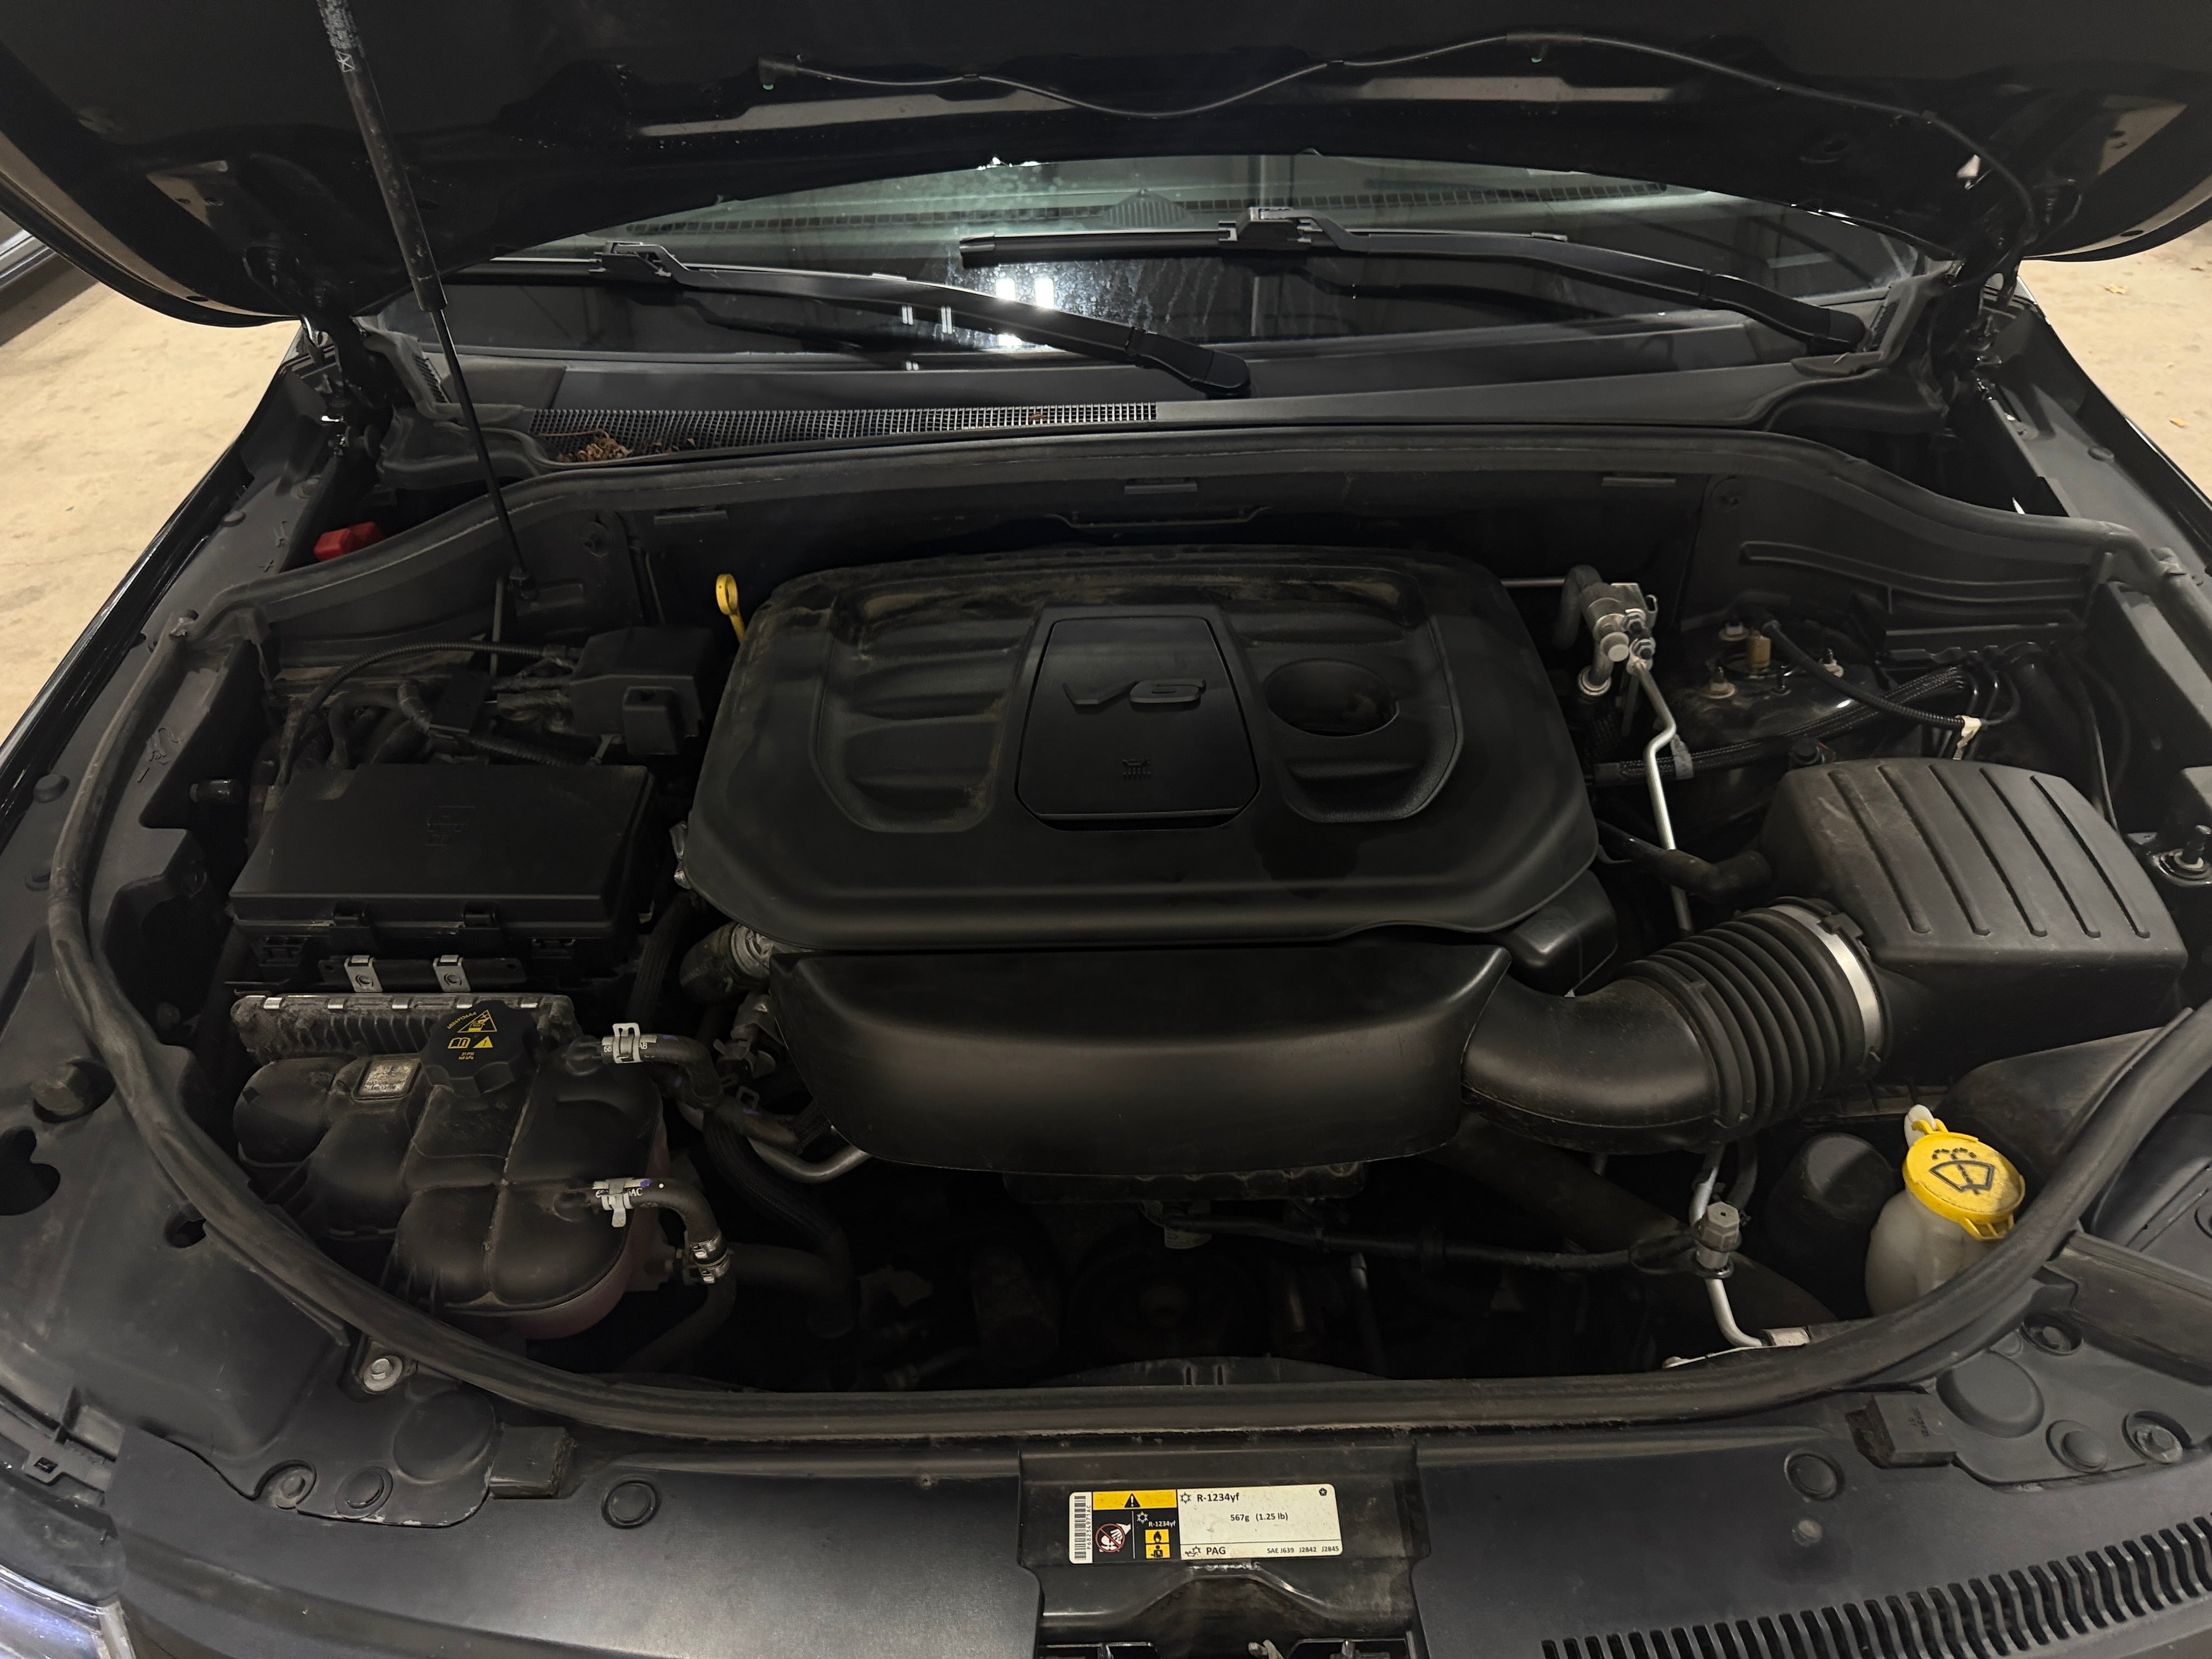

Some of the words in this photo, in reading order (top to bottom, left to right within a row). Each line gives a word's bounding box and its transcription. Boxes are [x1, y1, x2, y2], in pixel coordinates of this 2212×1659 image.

[1062, 677, 1207, 713] V6
[1197, 1492, 1240, 1503] R-1234yf
[1230, 1514, 1250, 1522] 567g
[1256, 1513, 1276, 1522] (1.25
[1278, 1512, 1288, 1521] lb)
[1206, 1547, 1226, 1555] PAG
